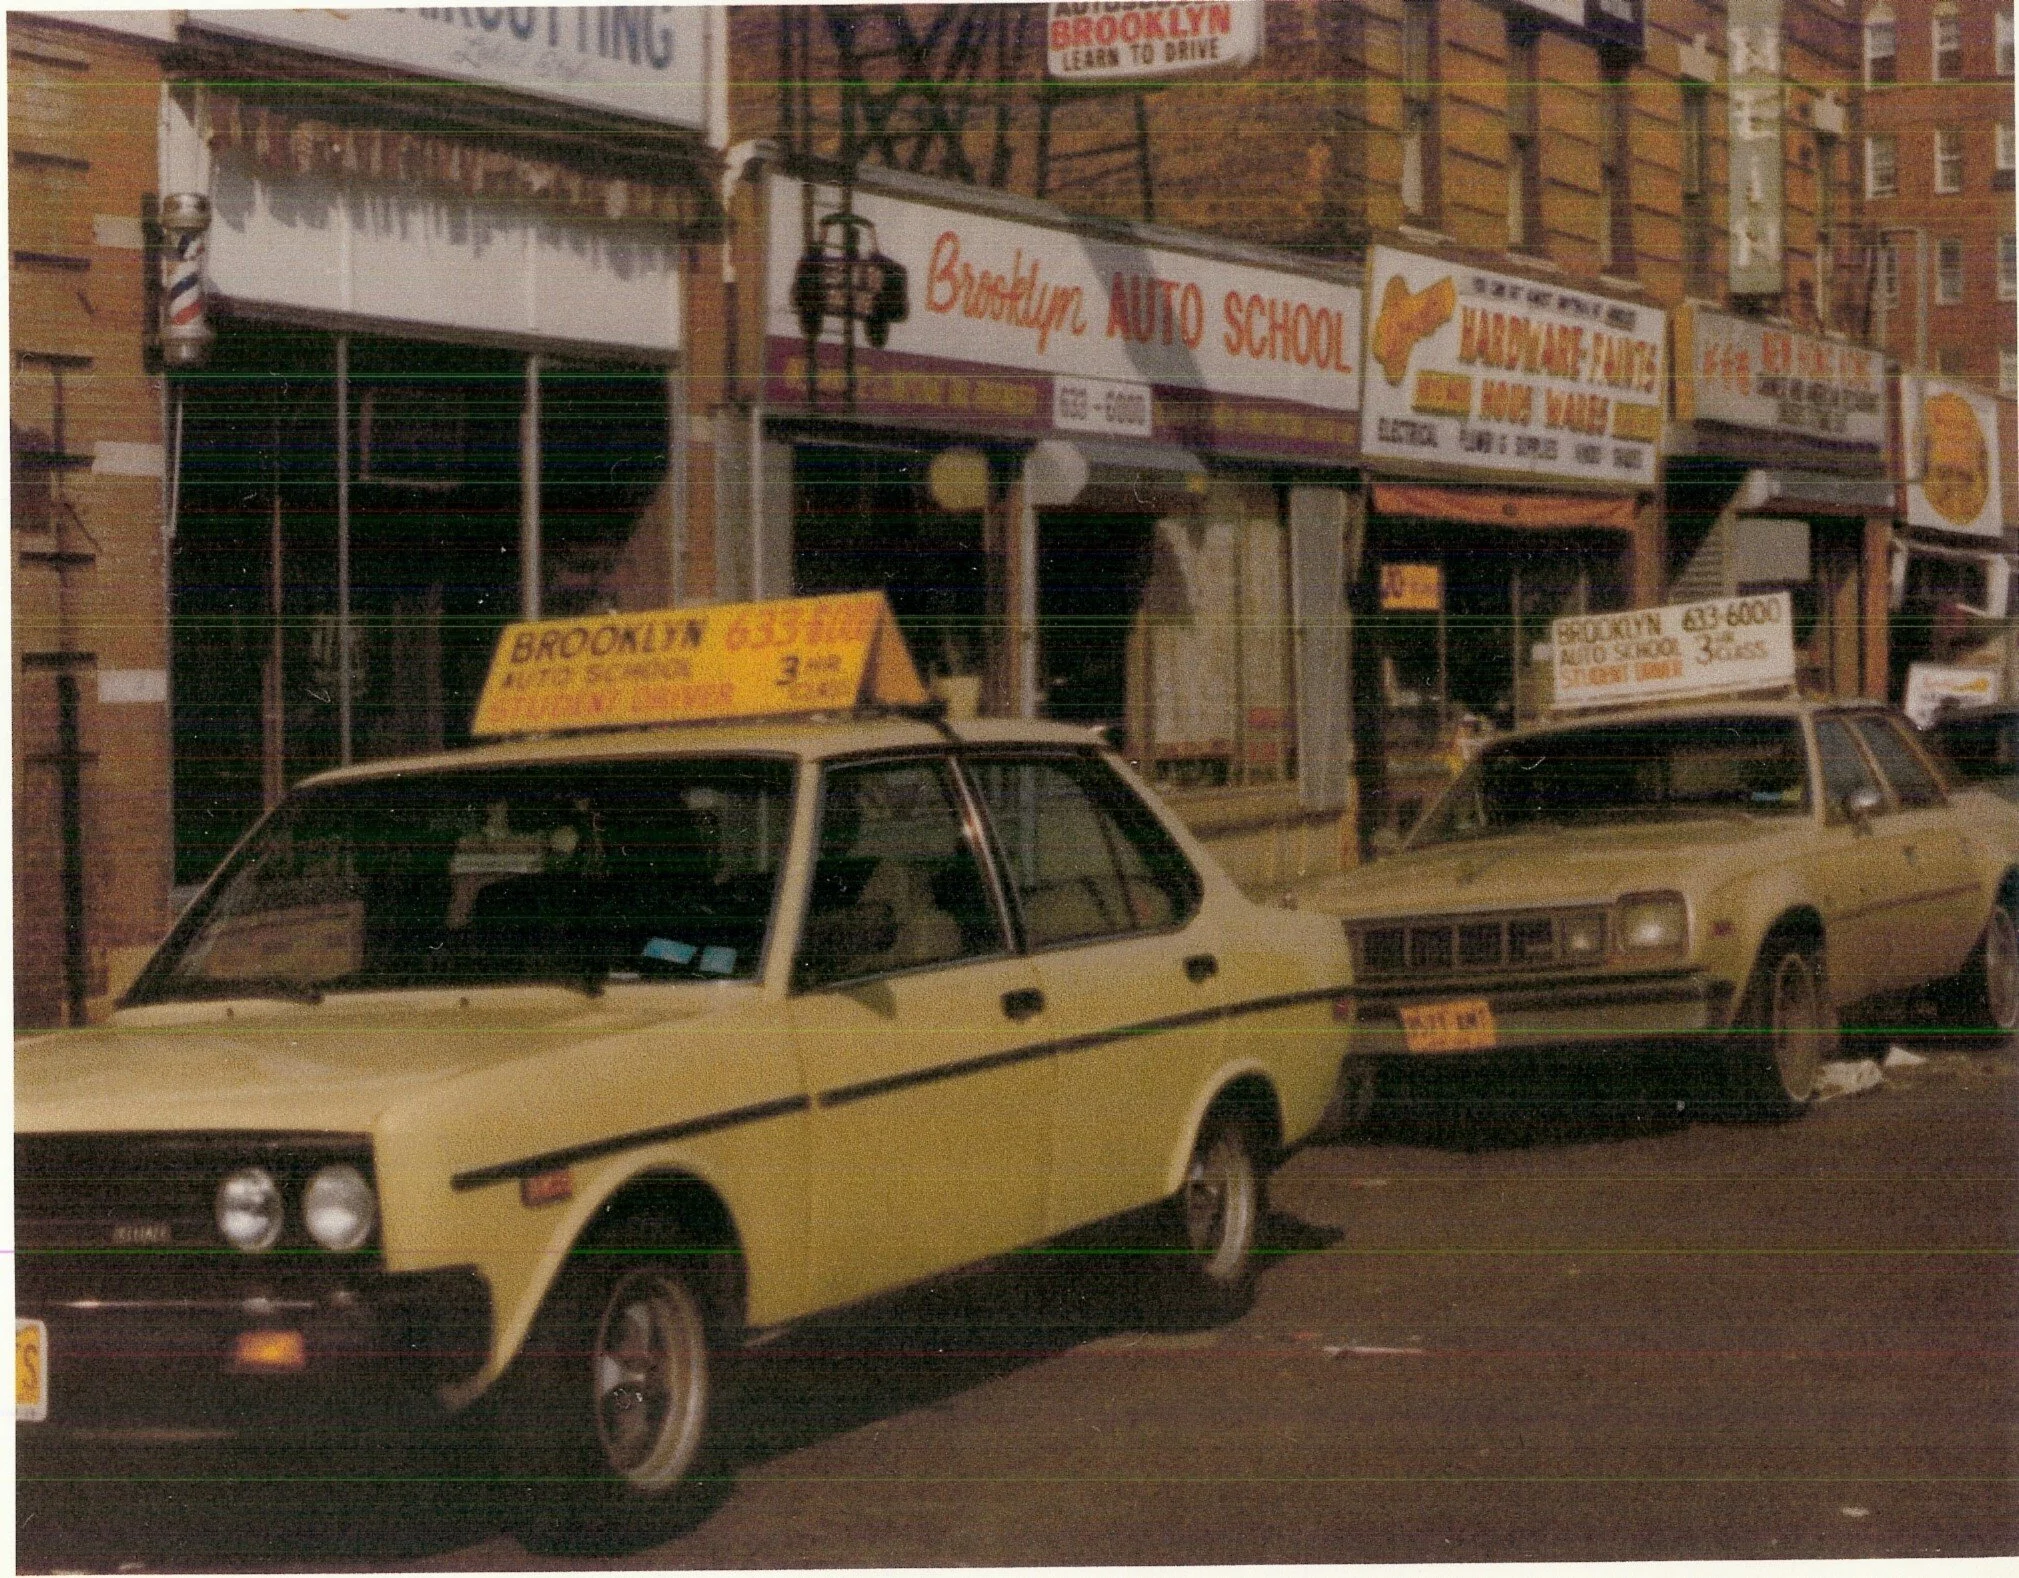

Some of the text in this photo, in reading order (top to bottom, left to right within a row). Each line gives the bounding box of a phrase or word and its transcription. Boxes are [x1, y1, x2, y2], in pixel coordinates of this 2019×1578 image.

[1050, 5, 1231, 51] BROOKLYN
[1062, 37, 1219, 71] LEARN TO DRIVE
[926, 231, 1352, 374] Brooklyn AUTO SCHOOL
[510, 617, 709, 664] BROOKLYN
[1557, 611, 1661, 645] BROOKLYN
[1561, 637, 1682, 666] AUTO SCHOOL
[1694, 634, 1714, 666] 3
[503, 658, 692, 690] AUTO SCHOOL
[776, 655, 800, 687] 3
